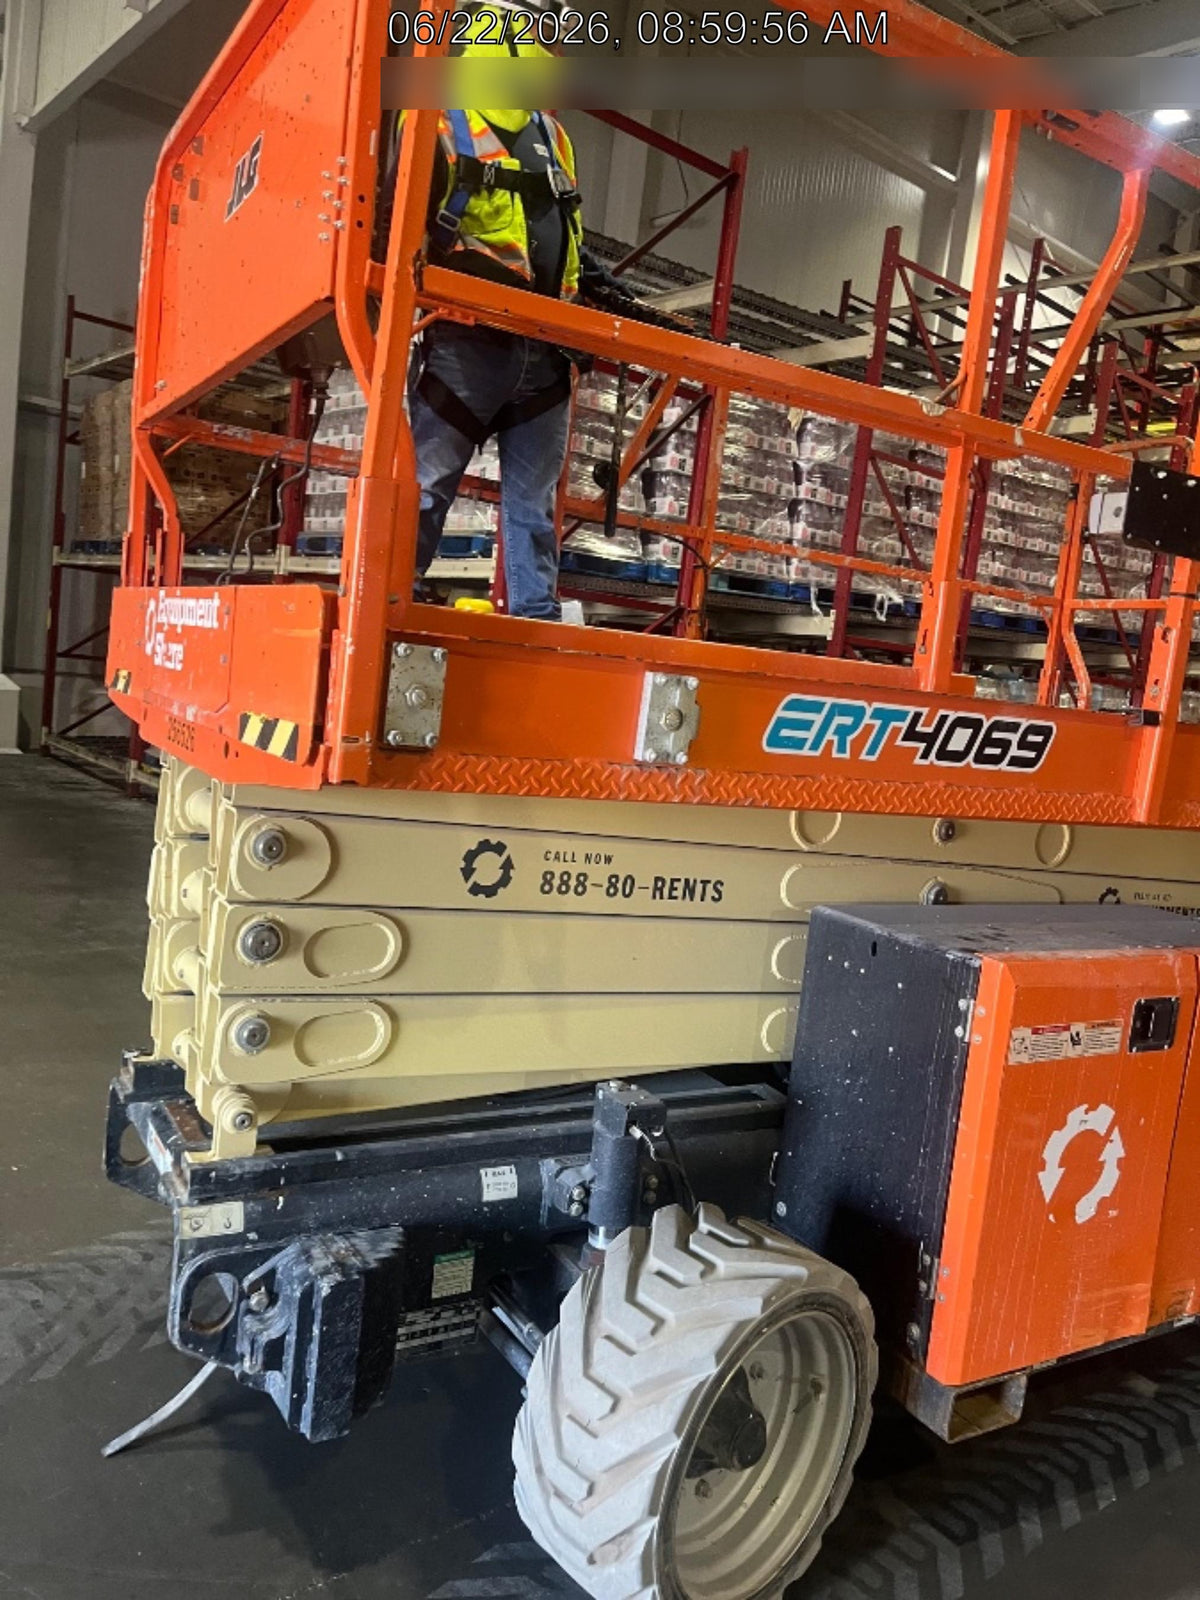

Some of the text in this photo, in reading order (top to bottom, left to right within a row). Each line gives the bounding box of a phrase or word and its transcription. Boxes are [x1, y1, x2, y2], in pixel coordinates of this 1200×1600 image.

[762, 693, 1057, 773] ERT4069
[543, 849, 614, 865] CALL NOW
[540, 870, 724, 902] 888-80-RENTS
